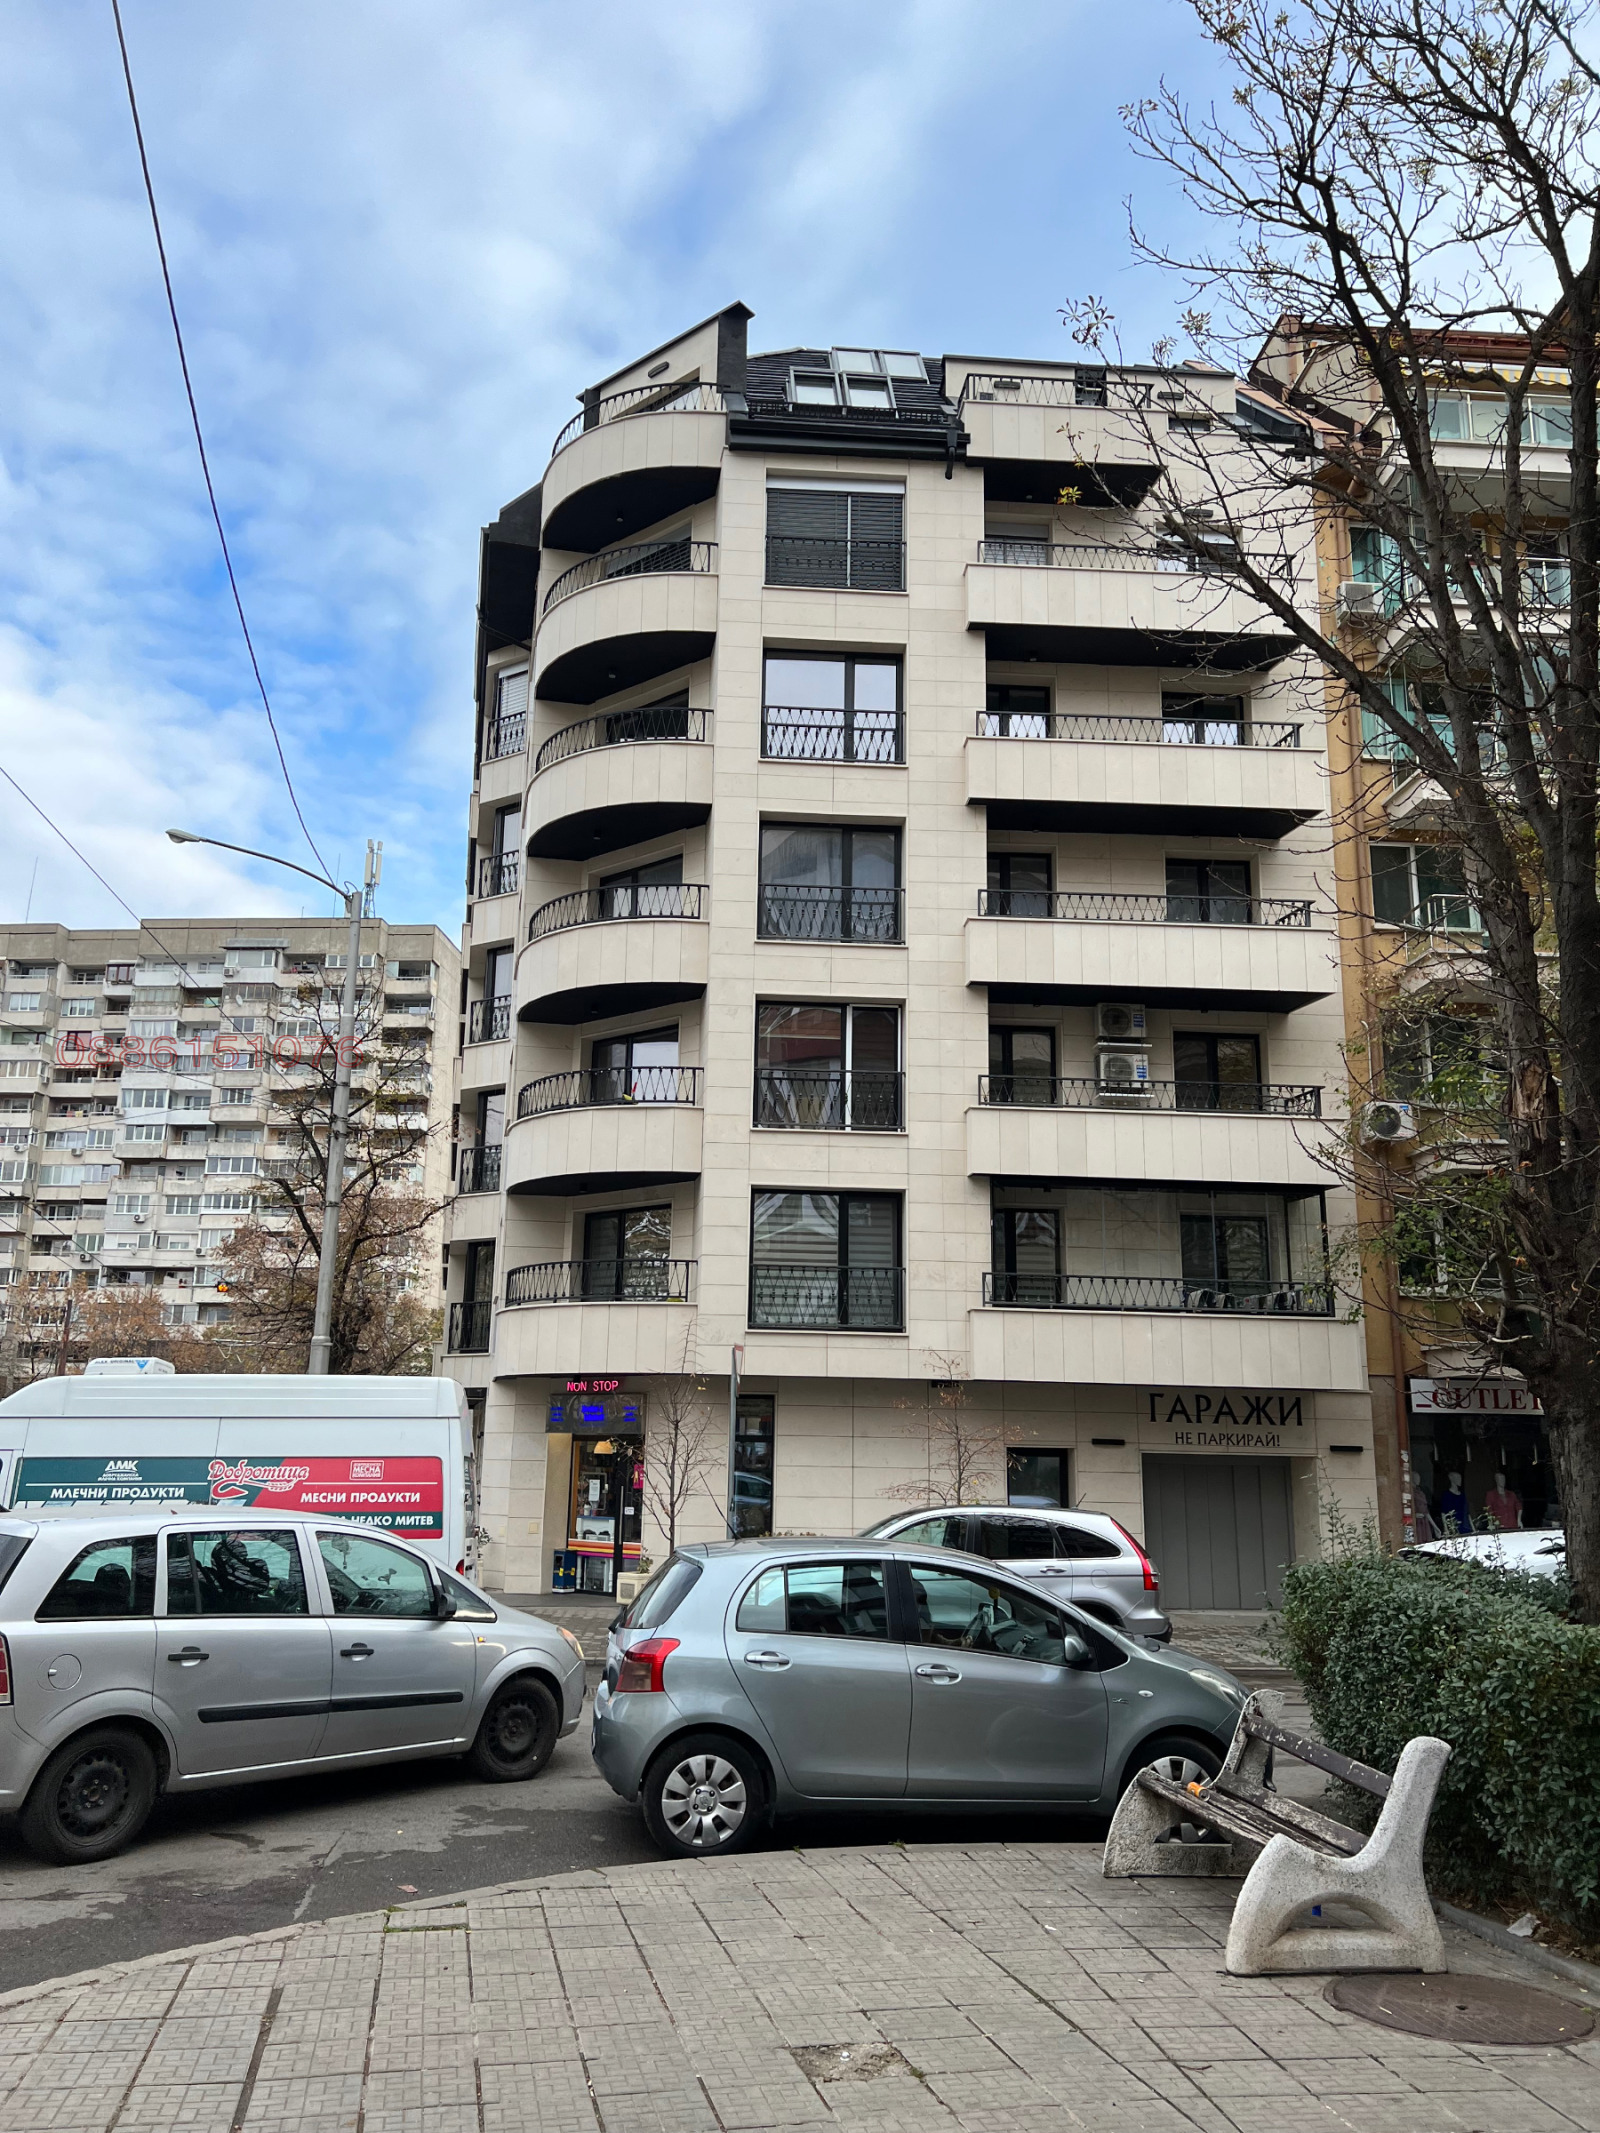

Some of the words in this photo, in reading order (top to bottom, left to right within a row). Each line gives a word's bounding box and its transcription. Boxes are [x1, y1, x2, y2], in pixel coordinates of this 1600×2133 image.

[567, 1381, 587, 1392] NON
[592, 1380, 619, 1392] STOP
[1149, 1392, 1303, 1426] ГАРАЖИ
[1175, 1431, 1193, 1445] НЕ
[1198, 1432, 1280, 1447] ПАРКИРАЙ!
[207, 1459, 310, 1485] Добротица
[50, 1488, 107, 1498] МЛЕЧНИ
[111, 1487, 185, 1498] ПРОДУКТИ
[300, 1492, 347, 1503] МЕСНИ
[350, 1492, 420, 1503] ПРОДУКТИ
[395, 1515, 434, 1525] МИТЕВ
